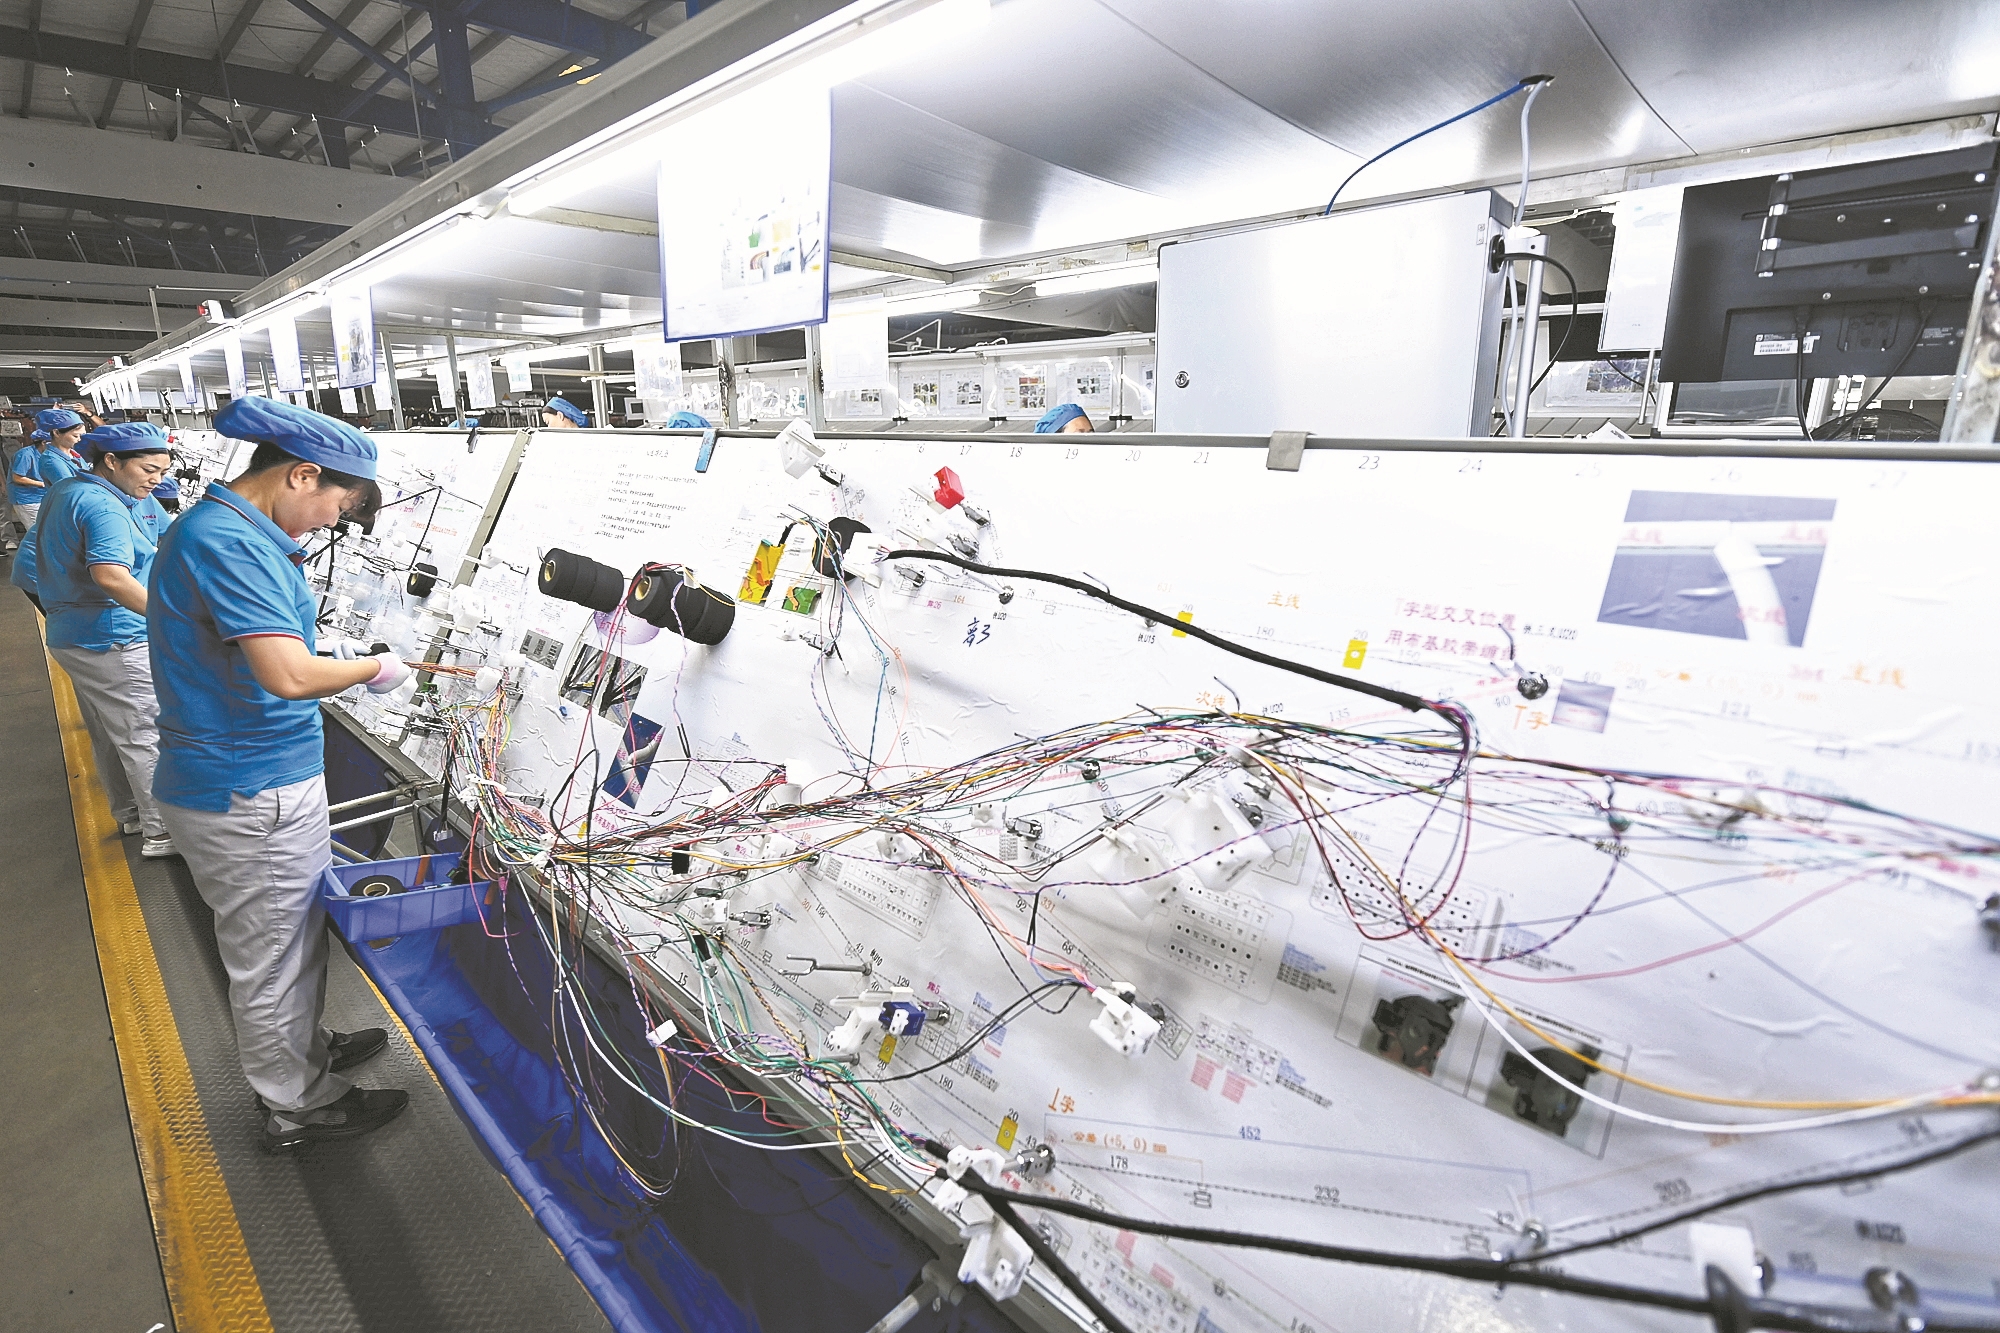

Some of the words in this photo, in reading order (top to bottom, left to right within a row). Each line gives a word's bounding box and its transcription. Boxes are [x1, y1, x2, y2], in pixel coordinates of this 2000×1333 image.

[960, 445, 973, 456] 17
[1009, 446, 1023, 458] 18
[1065, 448, 1079, 461] 19
[1125, 450, 1142, 463] 20
[1194, 451, 1210, 464] 21
[1358, 455, 1380, 470] 23
[1458, 457, 1484, 475] 24
[1574, 460, 1602, 480] 25
[1710, 464, 1743, 483] 26
[1870, 469, 1908, 490] 27
[1267, 590, 1301, 610] 主线
[1255, 624, 1275, 639] 180
[1353, 629, 1369, 641] 20
[1329, 707, 1350, 722] 135
[1512, 704, 1549, 731] T字
[1058, 764, 1069, 775] 74
[801, 897, 813, 913] 301
[1015, 899, 1027, 913] 92
[1040, 896, 1056, 913] 331
[1061, 940, 1074, 955] 68
[677, 971, 689, 986] 15
[896, 974, 910, 988] 129
[877, 1058, 888, 1071] 20
[939, 1073, 954, 1090] 180
[889, 1100, 902, 1118] 125
[1007, 1107, 1019, 1121] 20
[1238, 1125, 1262, 1141] 452
[1109, 1154, 1129, 1170] 178
[1069, 1181, 1083, 1201] 72
[1313, 1183, 1341, 1203] 232
